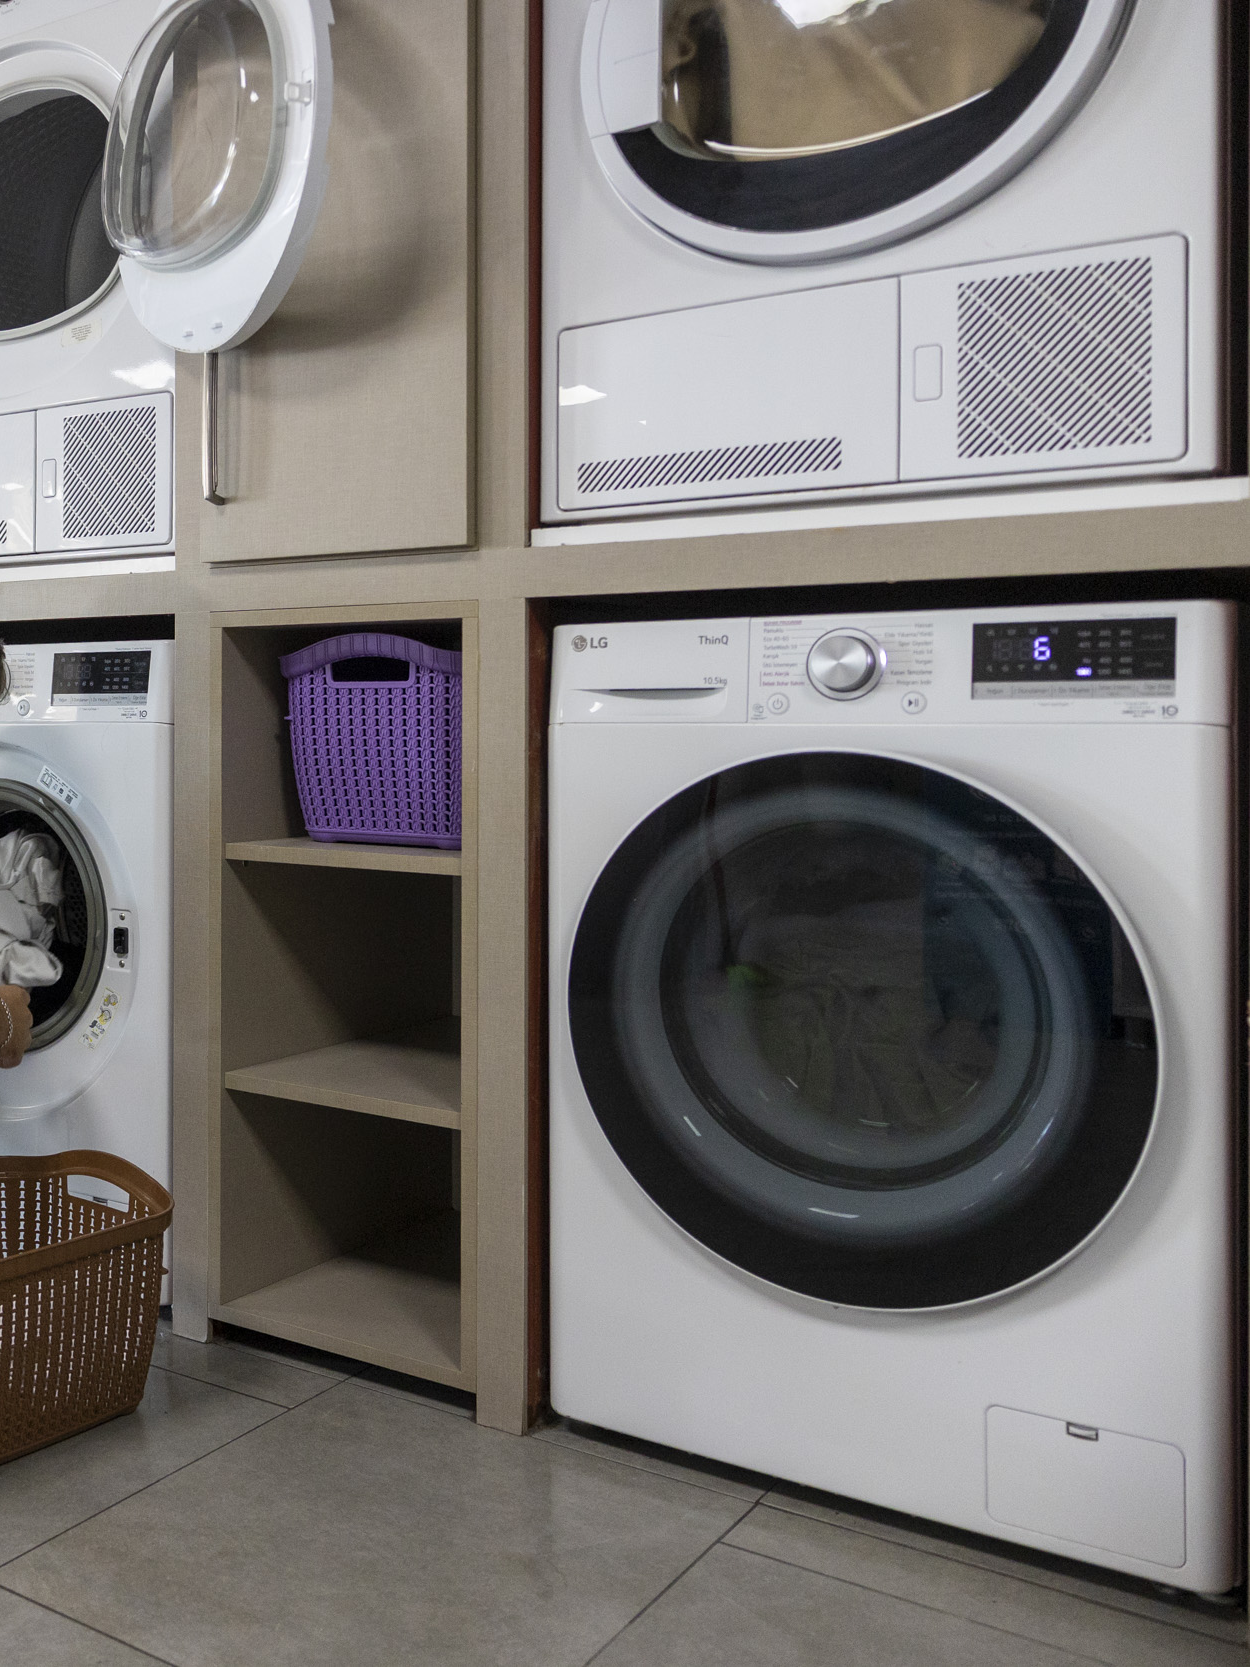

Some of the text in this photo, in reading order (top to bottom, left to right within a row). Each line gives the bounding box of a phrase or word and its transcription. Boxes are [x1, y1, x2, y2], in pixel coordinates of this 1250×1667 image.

[589, 637, 608, 649] LG
[698, 634, 729, 646] ThinQ
[1033, 636, 1052, 661] 6
[703, 677, 728, 687] 10.5kg
